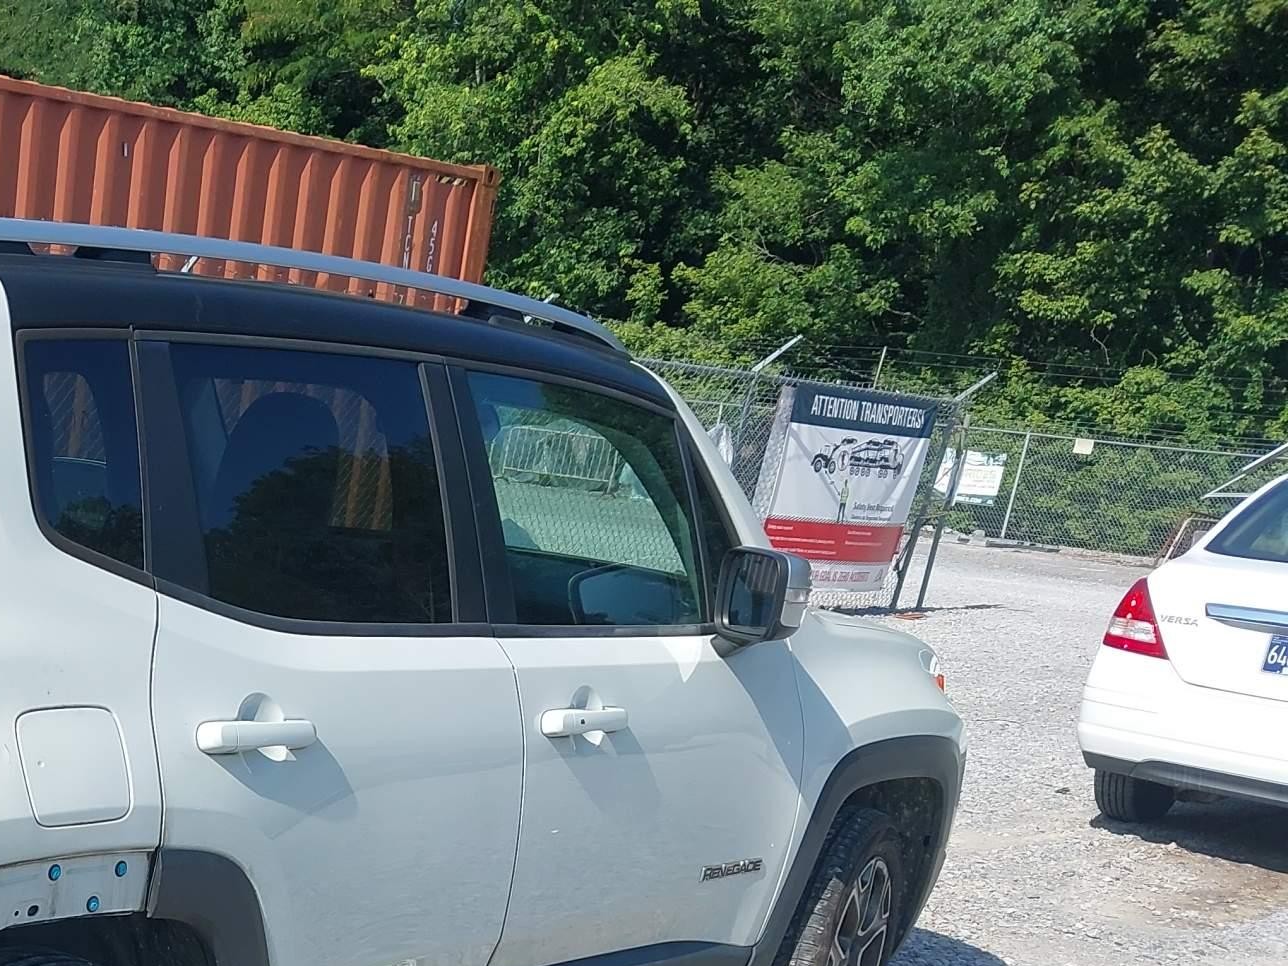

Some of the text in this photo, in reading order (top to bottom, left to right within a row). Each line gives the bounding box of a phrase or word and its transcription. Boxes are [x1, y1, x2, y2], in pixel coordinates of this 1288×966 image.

[811, 394, 859, 421] ATTENTION
[1160, 614, 1199, 627] VERSA
[1268, 644, 1288, 666] 64
[700, 857, 763, 882] RENEGADE
